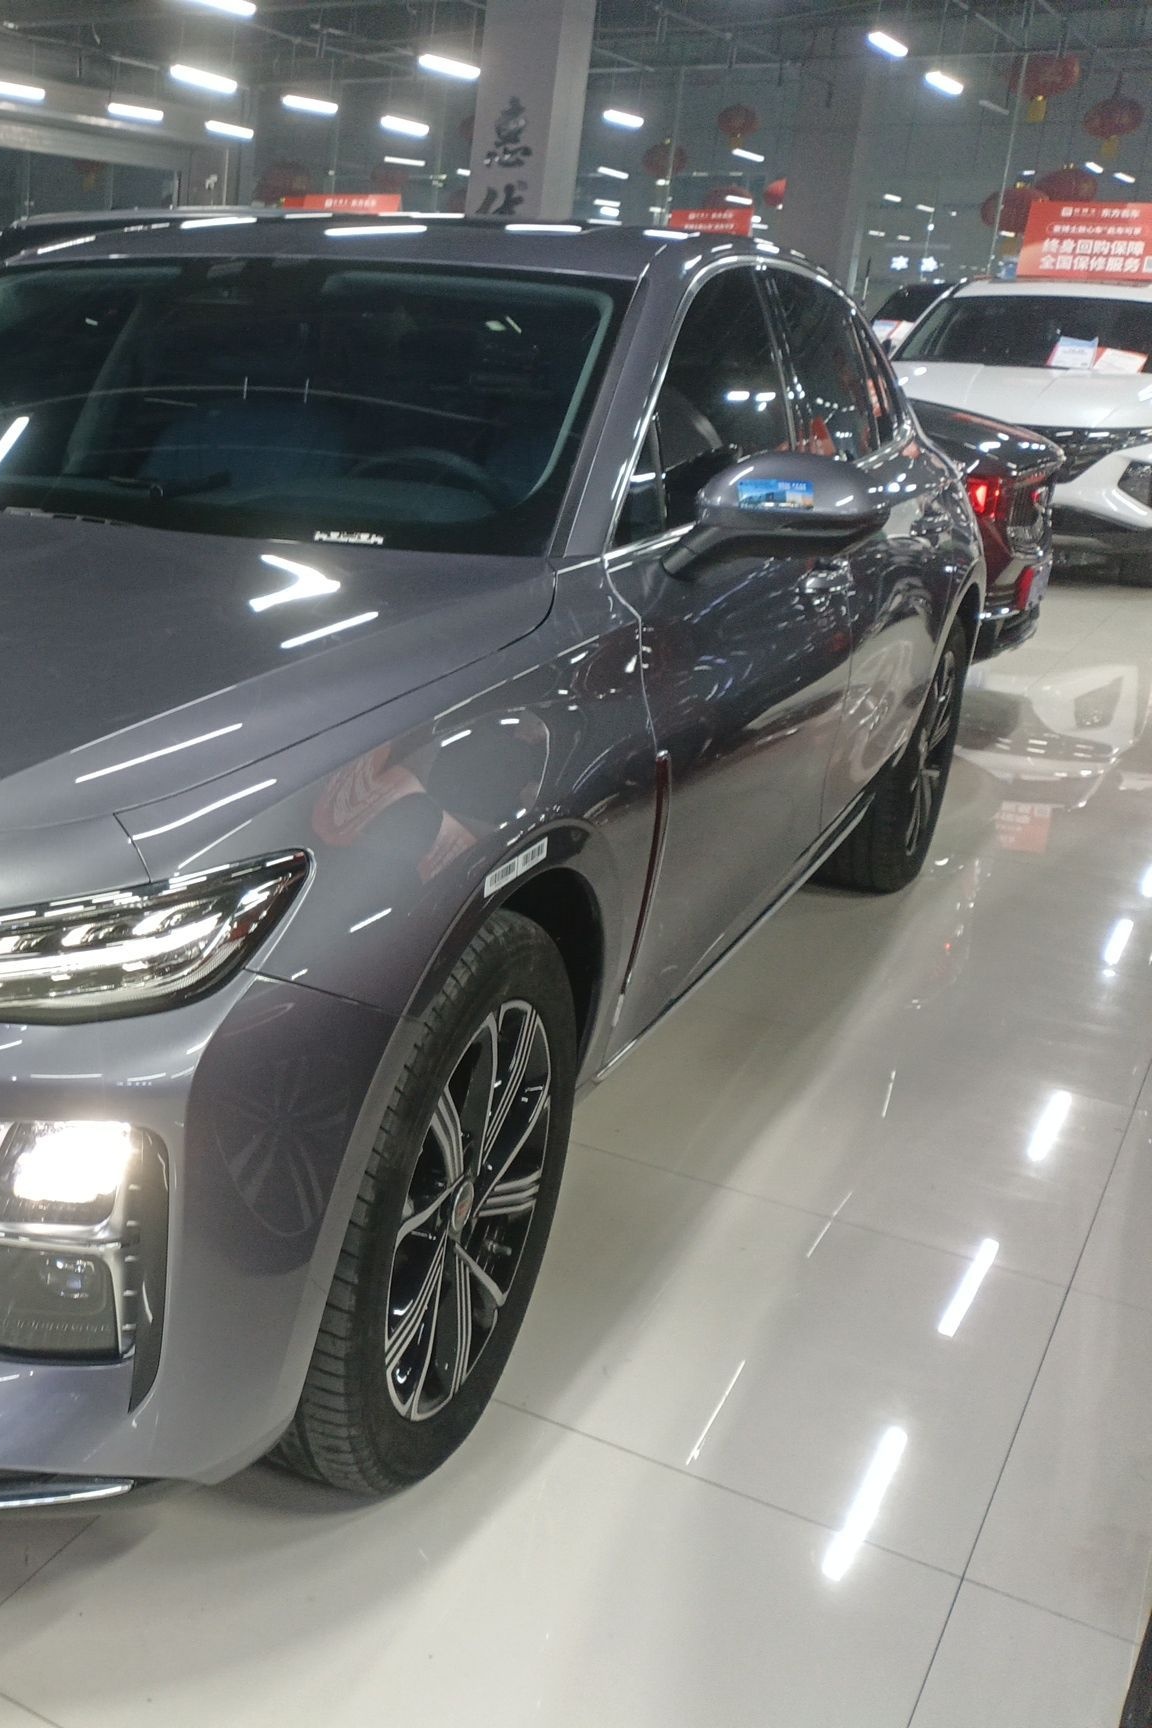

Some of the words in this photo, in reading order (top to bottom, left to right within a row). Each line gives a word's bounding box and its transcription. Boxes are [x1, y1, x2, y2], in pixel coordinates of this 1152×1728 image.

[1041, 238, 1146, 256] 终身回购保障
[1039, 254, 1142, 273] 全国保修服务
